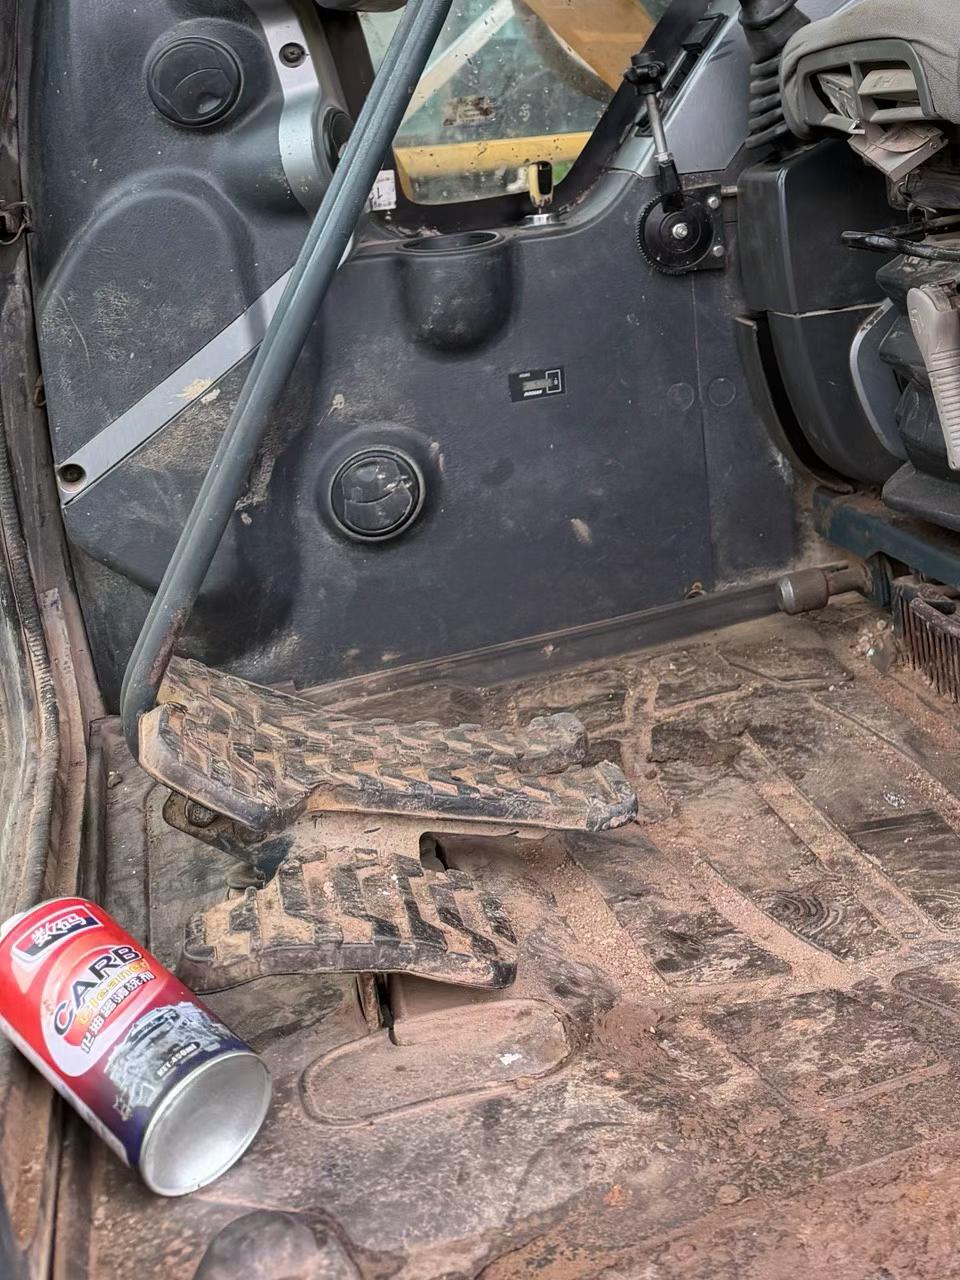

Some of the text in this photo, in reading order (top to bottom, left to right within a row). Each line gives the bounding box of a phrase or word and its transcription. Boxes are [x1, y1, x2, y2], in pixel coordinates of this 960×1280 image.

[53, 945, 143, 1036] CARB
[80, 970, 156, 1054] 化油器清洗剂
